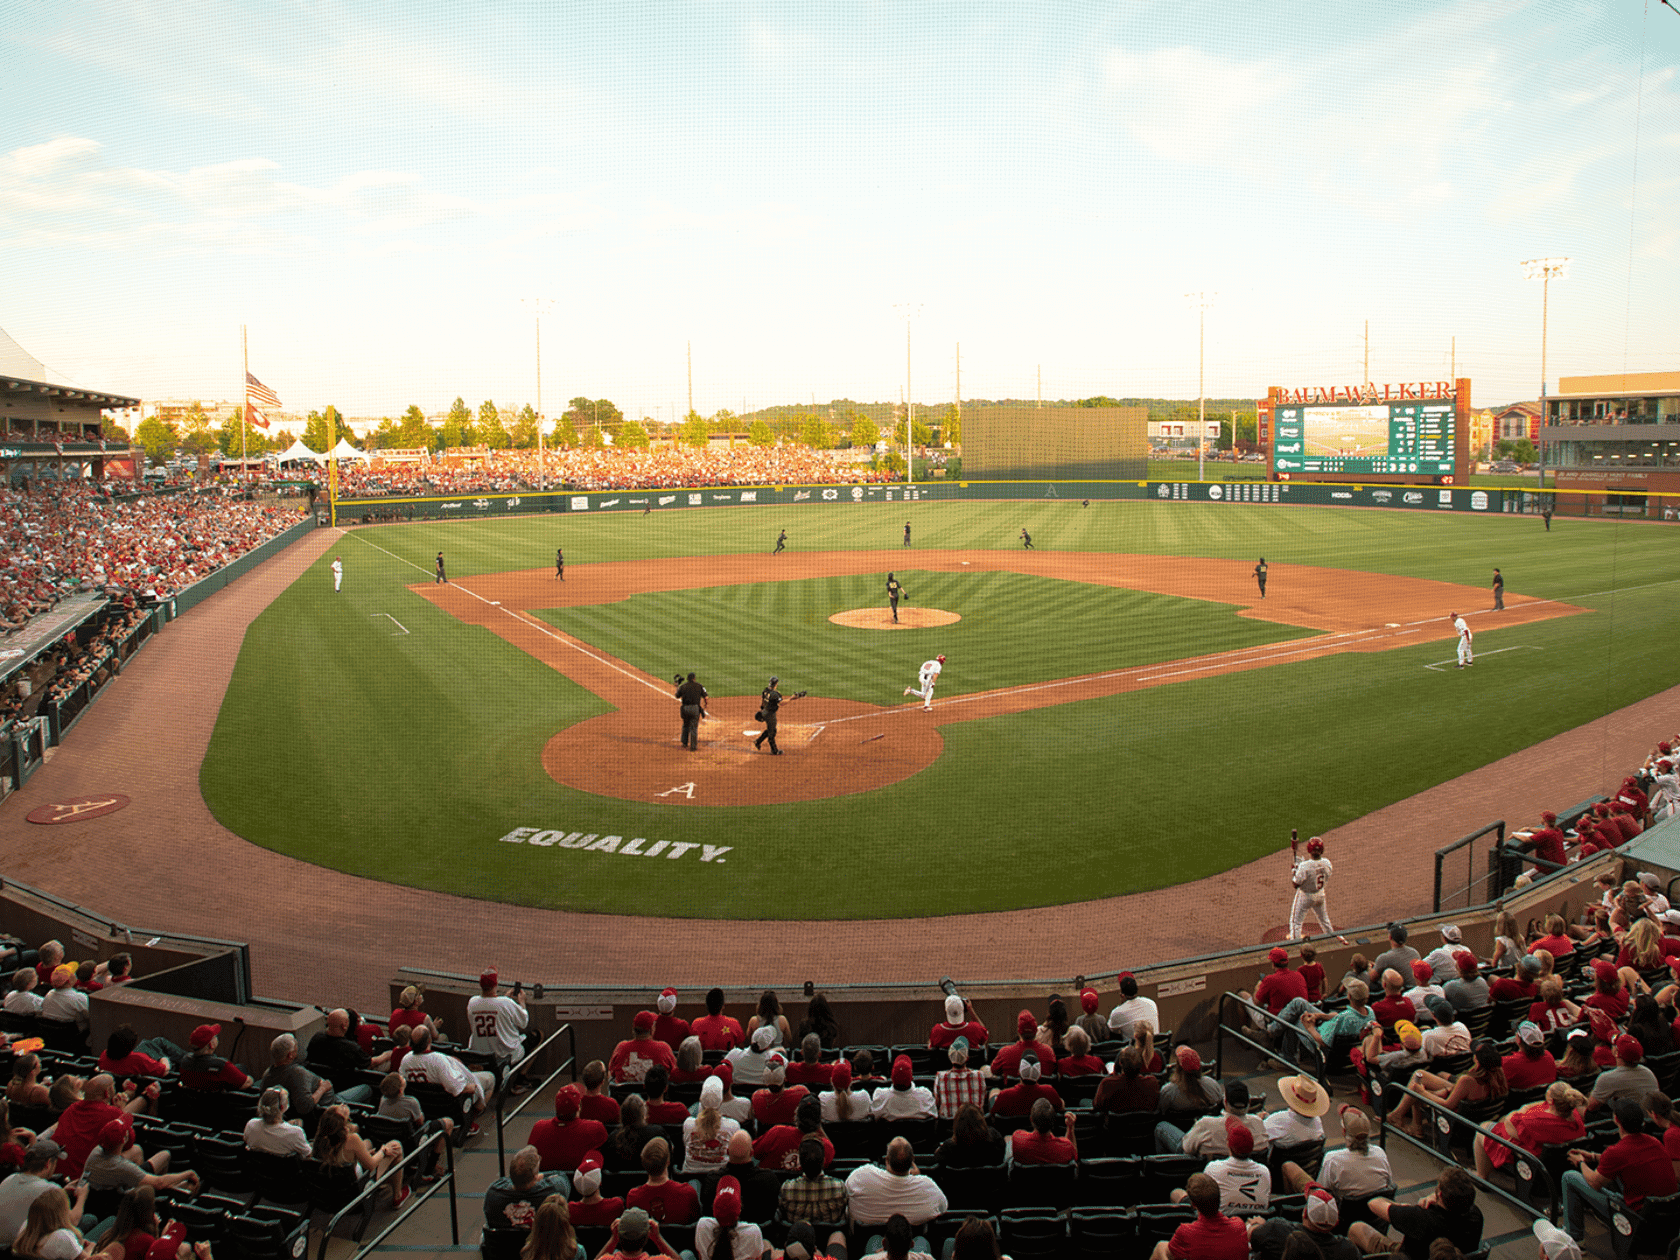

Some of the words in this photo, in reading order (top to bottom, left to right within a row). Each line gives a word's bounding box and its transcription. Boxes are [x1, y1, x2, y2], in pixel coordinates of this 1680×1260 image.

[1277, 381, 1454, 406] BAUM-WALKER
[1389, 463, 1397, 472] 3
[1399, 463, 1407, 472] 2
[1409, 463, 1417, 472] 0
[654, 782, 697, 799] A
[499, 826, 734, 864] EQUALITY.
[475, 1015, 497, 1037] 22
[1545, 1007, 1573, 1029] 10
[1228, 1201, 1266, 1210] EASTON
